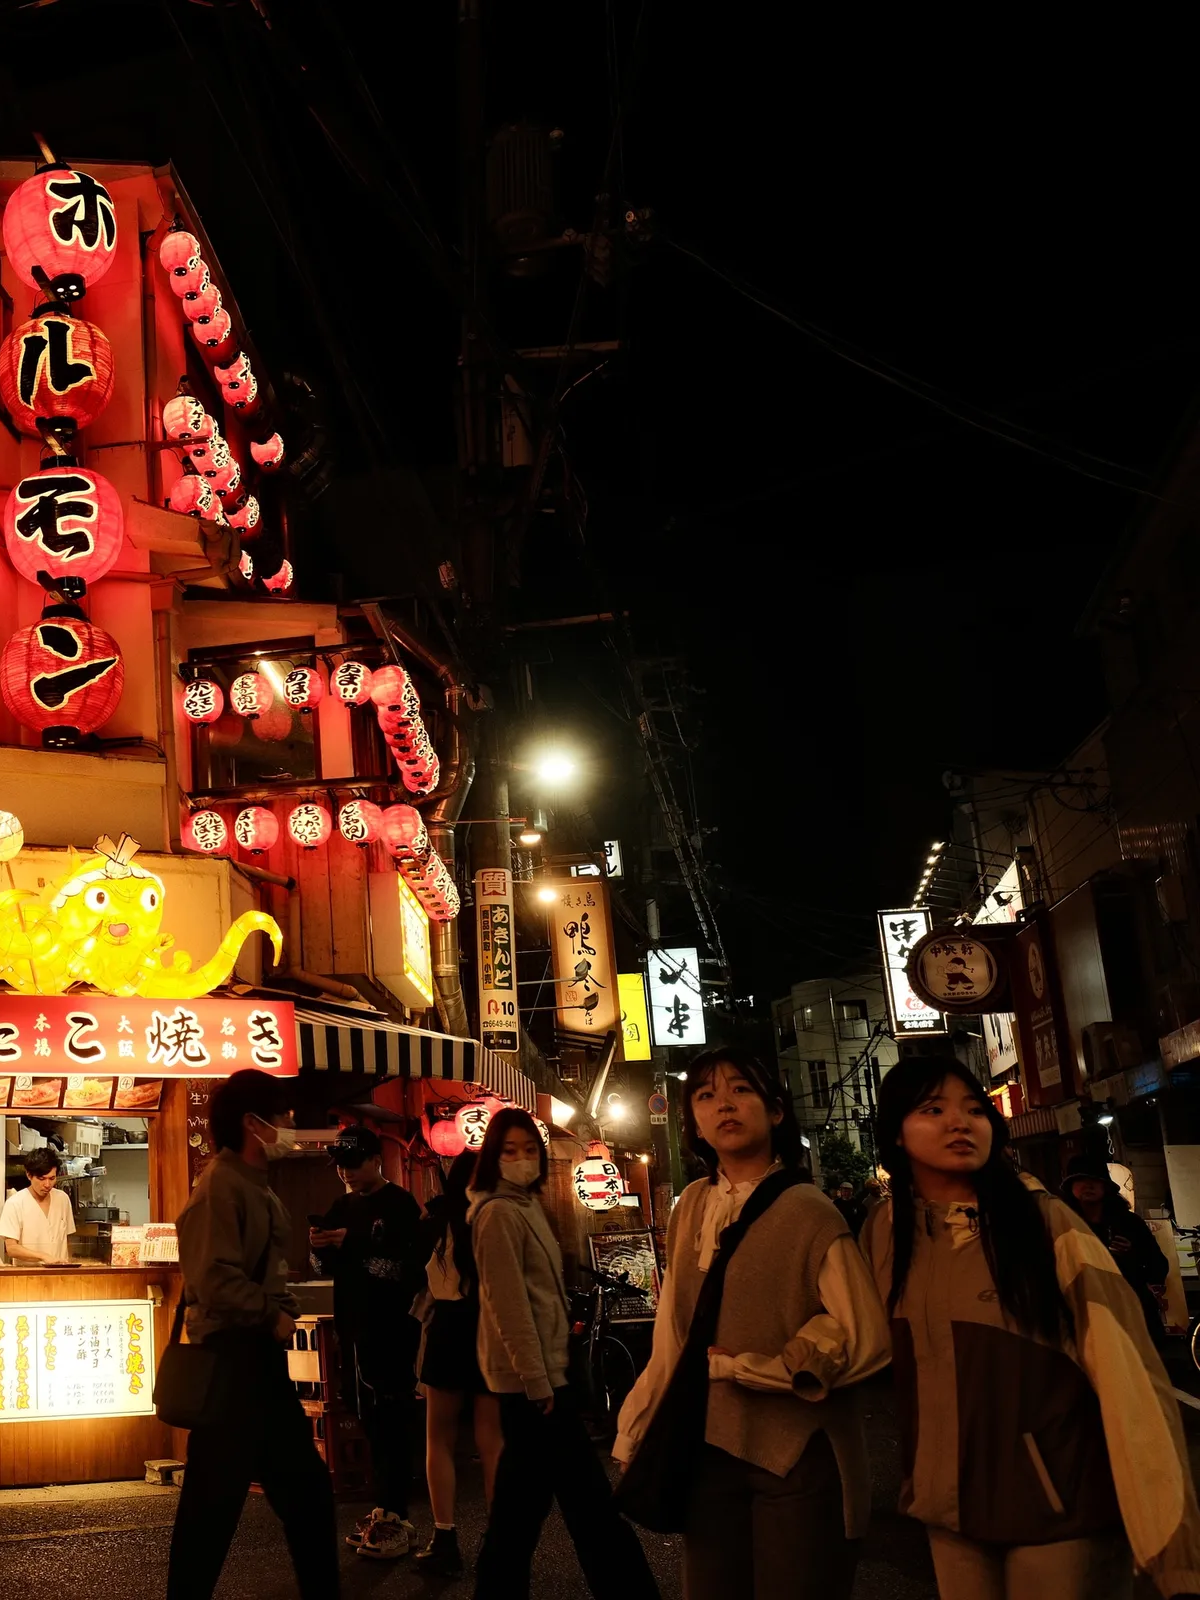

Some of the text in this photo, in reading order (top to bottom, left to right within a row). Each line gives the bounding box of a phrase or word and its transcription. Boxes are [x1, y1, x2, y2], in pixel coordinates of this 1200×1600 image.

[13, 171, 118, 711] ホルモン
[286, 670, 310, 703] あほか
[482, 872, 507, 896] 質
[562, 892, 596, 908] 焼き鳥
[492, 906, 511, 987] あきんど
[502, 1001, 515, 1016] 10
[33, 1013, 52, 1058] 本場
[117, 1015, 136, 1059] 大阪
[220, 1017, 238, 1060] 名物
[602, 1163, 619, 1206] 日本酒
[103, 1323, 114, 1360] ソース
[125, 1312, 145, 1395] たこ焼き
